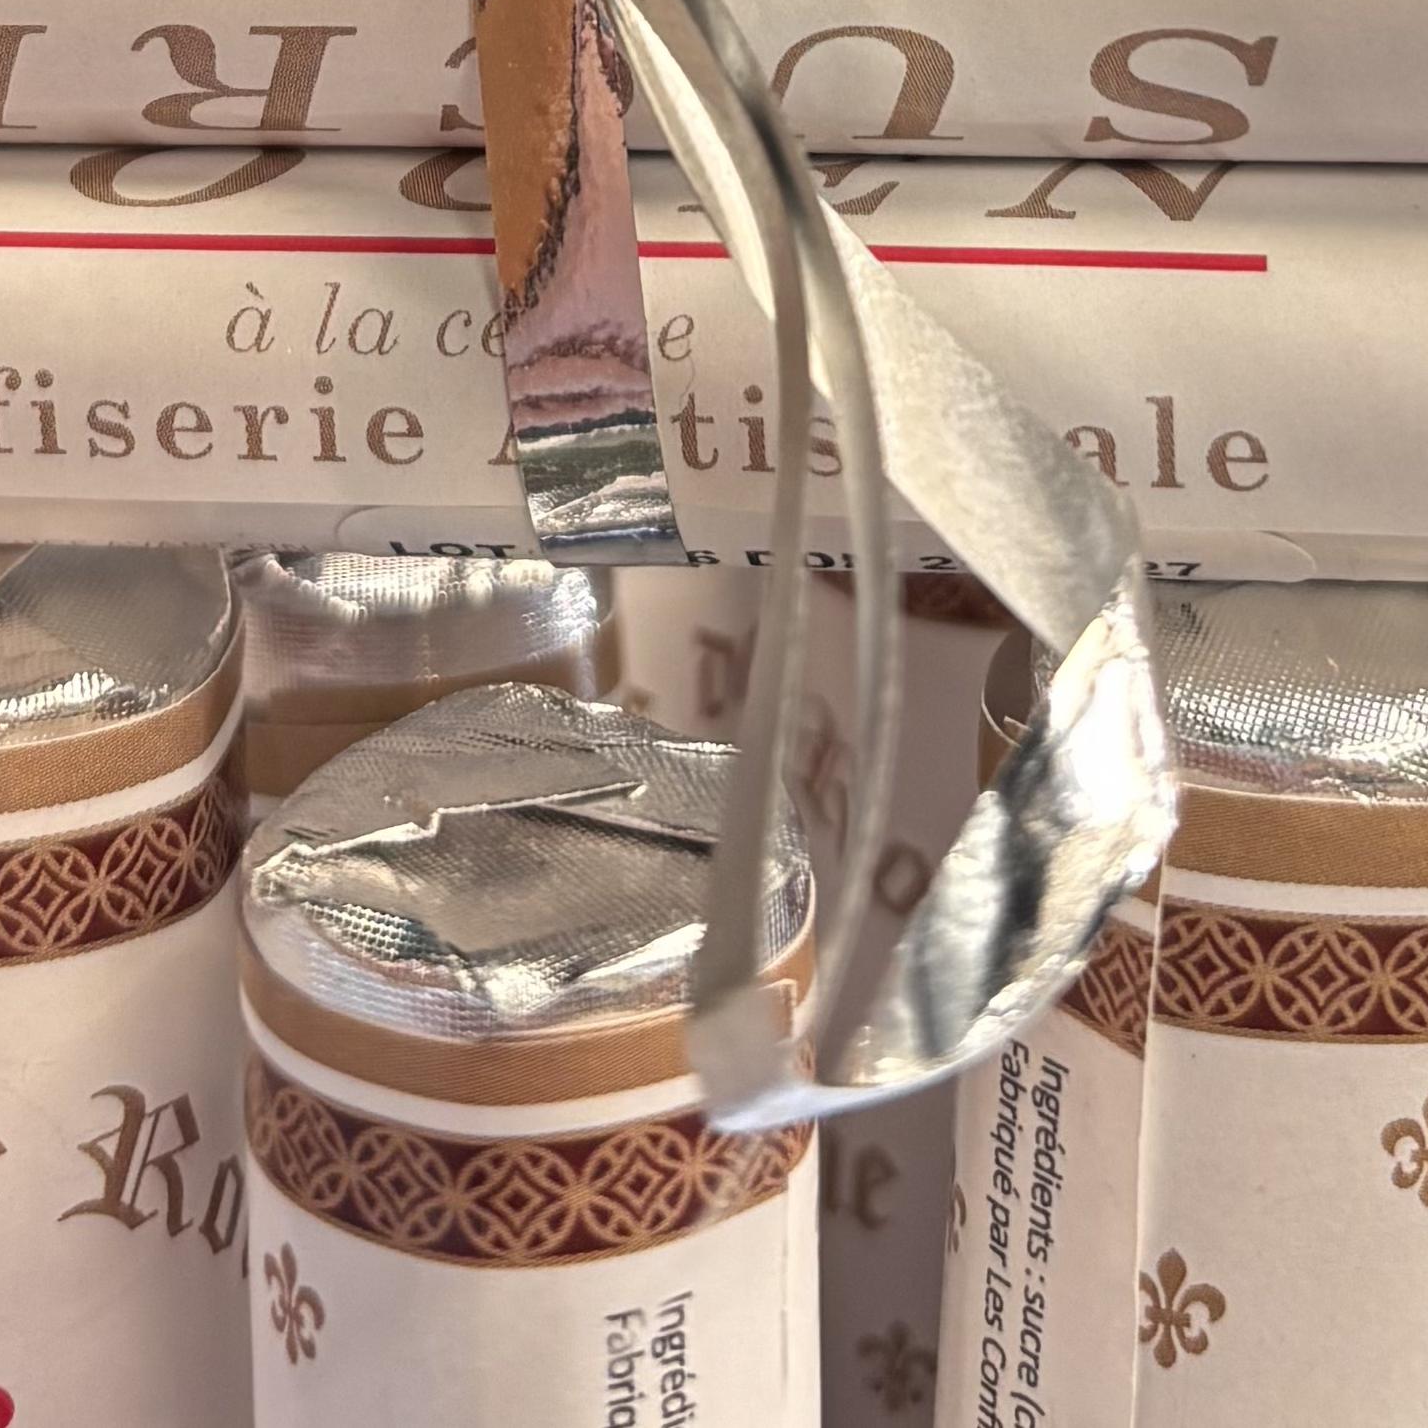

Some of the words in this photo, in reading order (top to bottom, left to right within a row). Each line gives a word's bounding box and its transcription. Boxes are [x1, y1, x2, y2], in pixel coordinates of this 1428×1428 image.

[224, 281, 276, 356] à
[313, 281, 402, 358] la
[989, 1039, 1030, 1200] Fabriqué
[1025, 1055, 1070, 1268] Ingrédients
[985, 1194, 1012, 1268] par
[983, 1266, 1012, 1332] Les
[1017, 1284, 1045, 1389] sucre
[650, 1290, 697, 1428] Ingrédi
